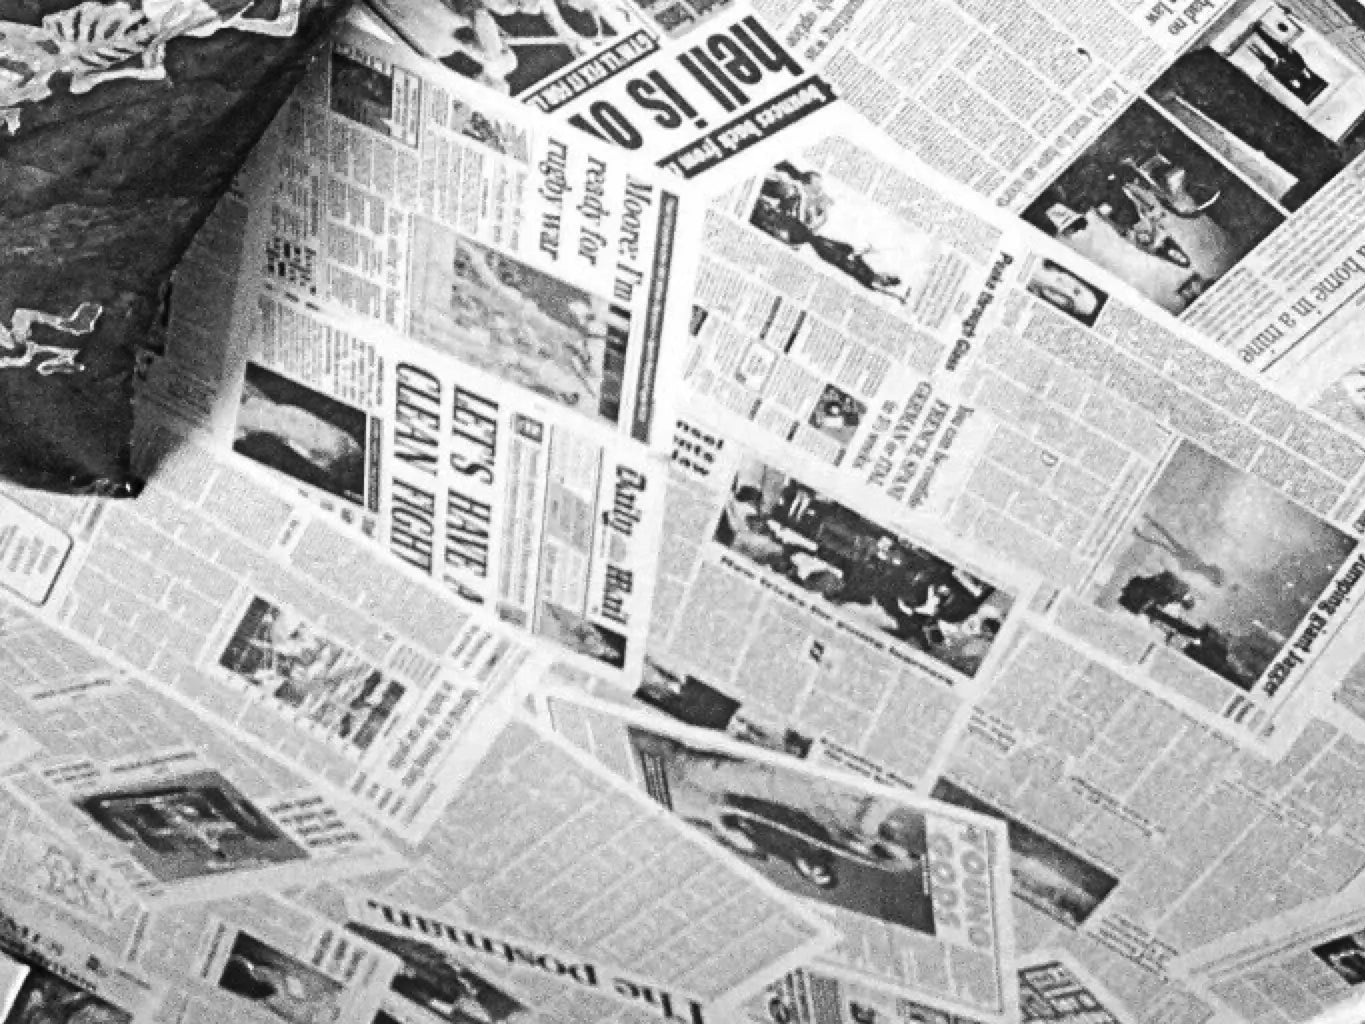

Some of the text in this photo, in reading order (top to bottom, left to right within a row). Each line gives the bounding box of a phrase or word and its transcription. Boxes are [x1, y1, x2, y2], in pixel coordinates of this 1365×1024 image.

[677, 16, 804, 112] hell
[626, 70, 708, 128] is
[576, 156, 610, 226] ready
[1278, 312, 1296, 335] a
[1291, 296, 1321, 316] in
[1238, 324, 1283, 364] mine
[390, 362, 441, 576] CLEAN FIGHT
[444, 385, 498, 577] LET'S HAVE
[1293, 612, 1327, 652] giant
[1263, 650, 1304, 698] Jagger
